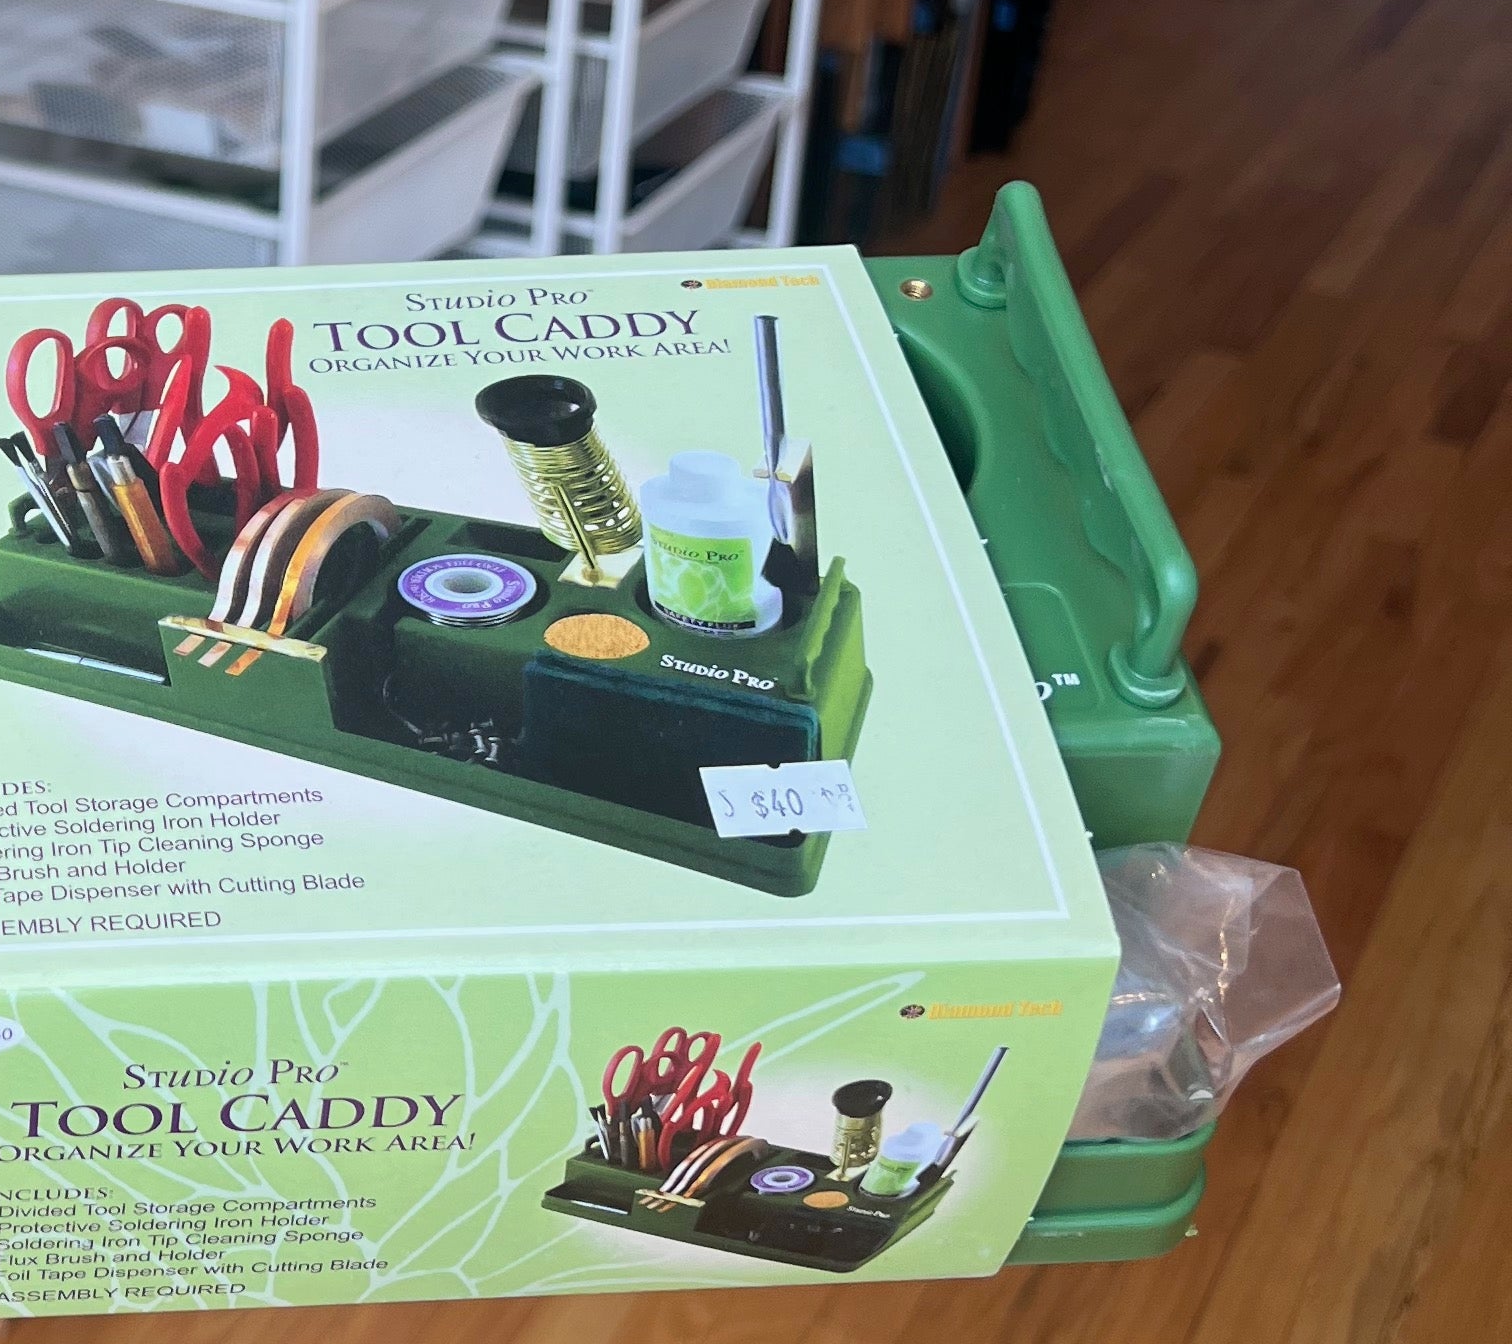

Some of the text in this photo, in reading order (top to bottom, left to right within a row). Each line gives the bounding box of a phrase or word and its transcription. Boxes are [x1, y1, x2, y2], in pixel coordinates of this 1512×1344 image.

[312, 309, 701, 352] TOOL CADDY
[309, 338, 731, 374] ORGANIZE YOUR WORK AREA!
[24, 798, 68, 815] Tool
[76, 794, 159, 815] Storage
[165, 788, 324, 809] Compartments
[55, 816, 155, 837] Soldering
[163, 814, 203, 830] Iron
[210, 810, 280, 827] Holder
[51, 841, 92, 856] Iron
[98, 838, 131, 856] Tip
[138, 834, 233, 856] Cleaning
[241, 831, 324, 851] Sponge
[67, 862, 107, 877] and
[115, 858, 186, 875] Holder
[51, 882, 161, 903] Dispenser
[168, 879, 211, 895] with
[219, 876, 295, 896] Cutting
[303, 873, 365, 889] Blade
[90, 911, 222, 932] REQUIRED
[11, 1094, 465, 1138] TOOL CADDY
[169, 1139, 264, 1157] YOUR
[273, 1136, 377, 1153] WORK
[386, 1132, 475, 1151] AREA!
[84, 1203, 126, 1215] Tool
[134, 1200, 216, 1215] Storage
[224, 1196, 376, 1213] Compartments
[108, 1216, 207, 1232] Soldering
[214, 1215, 254, 1228] Iron
[261, 1213, 329, 1226] Holder
[103, 1235, 142, 1247] Iron
[150, 1233, 180, 1247] Tip
[186, 1231, 276, 1246] Cleaning
[284, 1228, 364, 1243] Sponge
[45, 1252, 105, 1264] Brush
[112, 1251, 153, 1263] and
[158, 1248, 226, 1261] Holder
[37, 1268, 87, 1281] Tape
[94, 1264, 197, 1280] Dispenser
[204, 1263, 244, 1275] with
[251, 1260, 323, 1275] Cutting
[329, 1258, 388, 1270] Blade
[124, 1283, 246, 1297] REQUIRED
